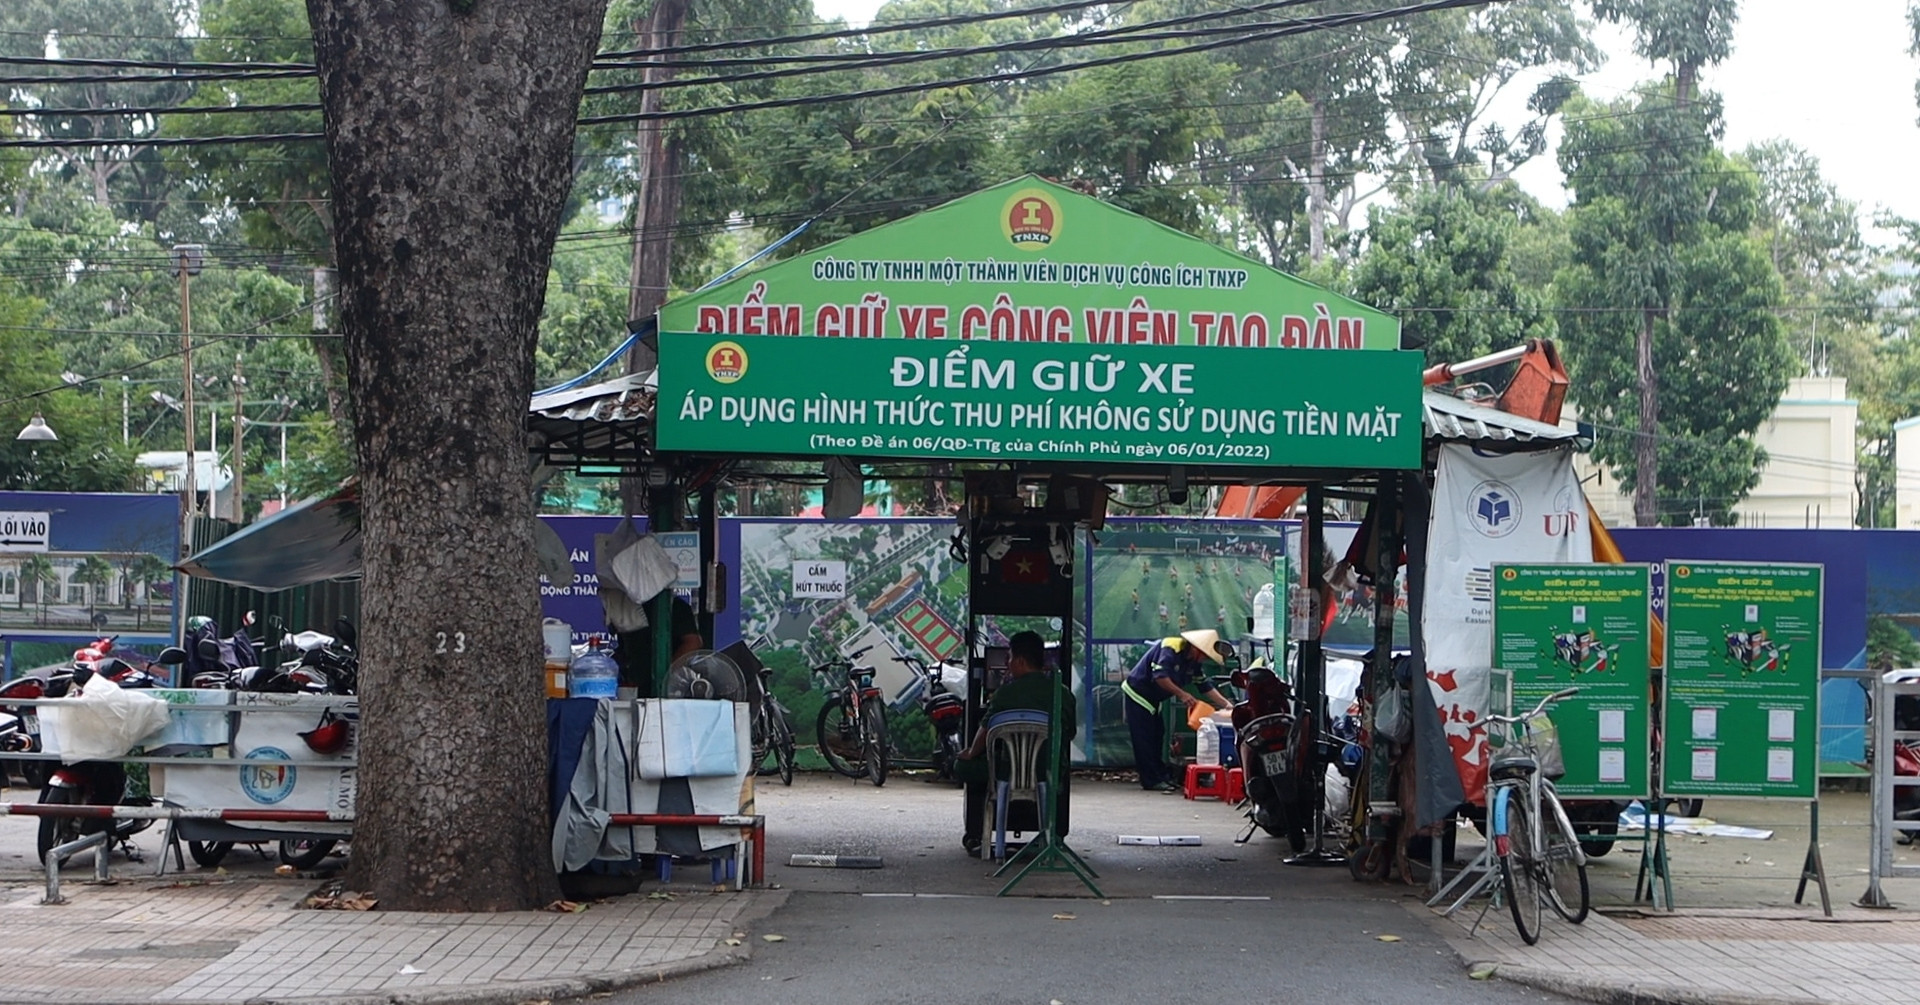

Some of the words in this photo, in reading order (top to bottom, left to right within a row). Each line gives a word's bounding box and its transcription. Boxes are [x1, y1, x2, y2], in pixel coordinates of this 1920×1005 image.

[1013, 232, 1050, 243] TNXP
[813, 257, 855, 280] CÔNG
[861, 261, 879, 280] TY
[884, 261, 924, 281] TNHH
[929, 258, 963, 285] MỘT
[967, 258, 1018, 281] THÀNH
[1023, 258, 1057, 282] VIÊN
[1063, 264, 1099, 287] DỊCH
[1104, 265, 1125, 288] VỤ
[1130, 262, 1171, 286] CÔNG
[1177, 263, 1203, 287] ÍCH
[1207, 269, 1247, 288] TNXP
[697, 281, 800, 336] ĐIỂM
[816, 293, 887, 339] GIỮ
[898, 307, 947, 340] XE
[961, 294, 1071, 343] CÔNG
[1085, 297, 1176, 345] VIÊN
[1280, 304, 1362, 350] ĐÀN
[890, 345, 1015, 390] ĐIỂM
[1032, 354, 1126, 392] GIỮ
[1137, 362, 1195, 394] XE
[679, 389, 714, 421] ÁP
[721, 397, 796, 428] DỤNG
[803, 392, 867, 425] HÌNH
[874, 394, 945, 427] THỨC
[951, 402, 1002, 428] THU
[1010, 398, 1054, 429] PHÍ
[1059, 400, 1150, 432] KHÔNG
[1157, 398, 1195, 433] SỬ
[1201, 408, 1276, 439] DỤNG
[1283, 400, 1338, 436] TIỀN
[1346, 405, 1401, 443] MẶT
[809, 434, 857, 449] (Theo
[861, 434, 883, 448] Đề
[888, 435, 908, 449] án
[912, 436, 1001, 454] 06/QĐ-TTg
[1005, 439, 1034, 453] của
[1038, 439, 1085, 454] Chính
[1089, 440, 1121, 455] Phủ
[1126, 443, 1163, 458] ngày
[1168, 443, 1271, 460] 06/01/2022)
[0, 514, 18, 536] LỐI
[21, 516, 46, 537] VÀO
[570, 547, 589, 563] ÁN
[808, 563, 827, 577] CẤM
[796, 580, 813, 593] HÚT
[814, 579, 843, 593] THUỐC
[435, 631, 466, 655] 23
